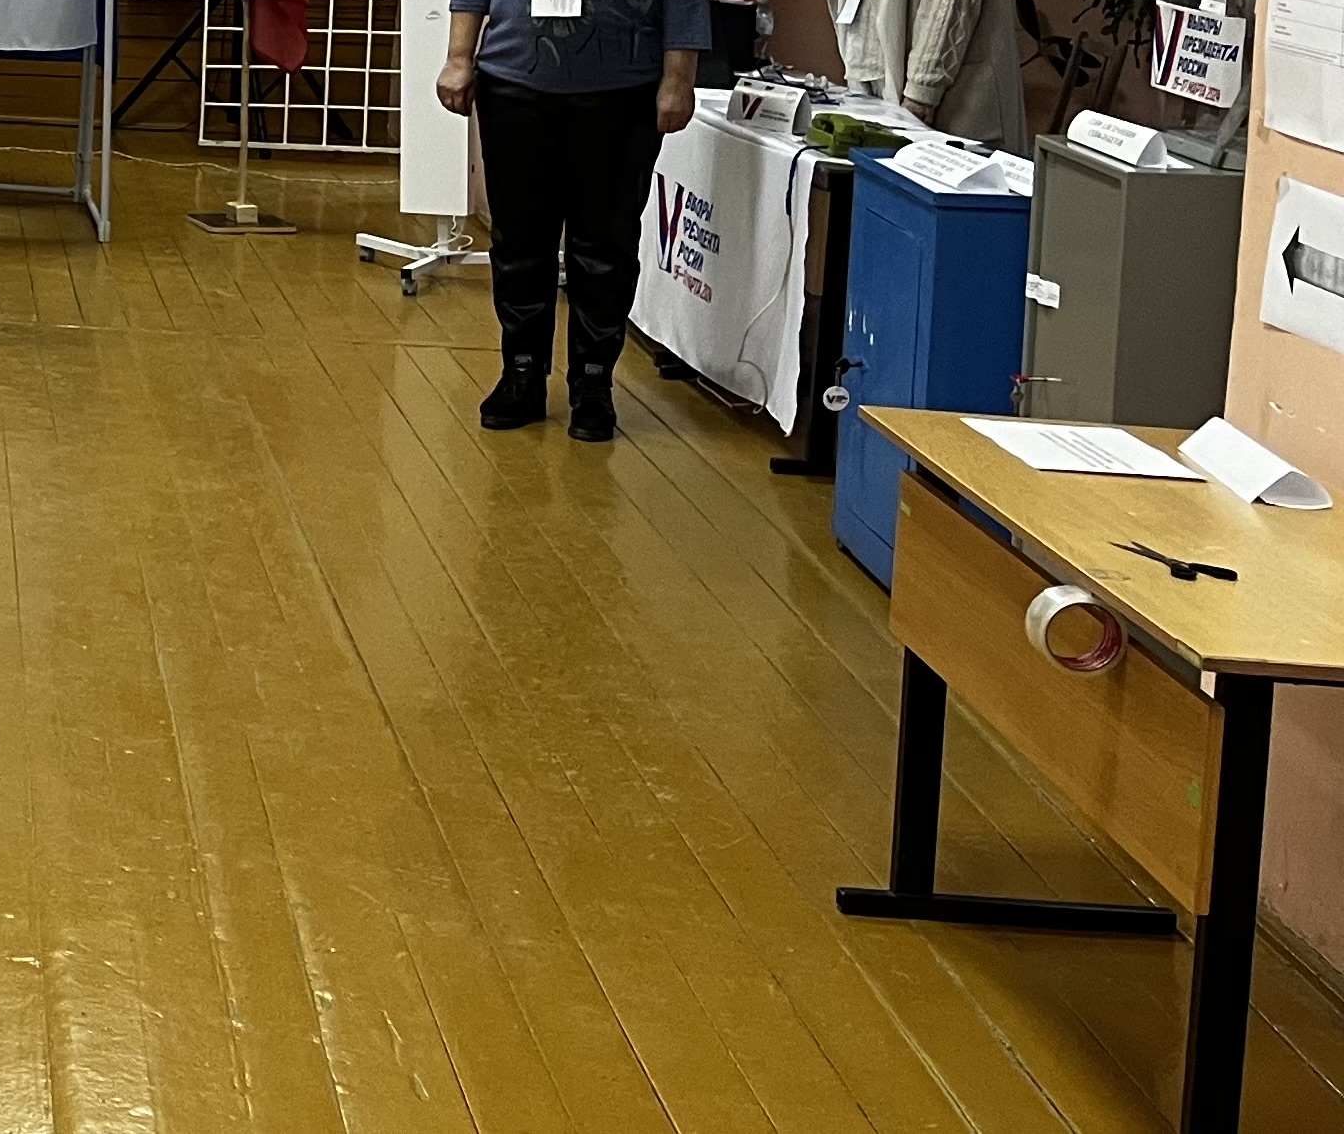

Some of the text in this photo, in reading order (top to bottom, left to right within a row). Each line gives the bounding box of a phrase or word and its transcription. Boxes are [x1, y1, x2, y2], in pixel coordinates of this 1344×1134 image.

[1187, 14, 1222, 35] ВЫБОРЫ
[1182, 35, 1239, 62] ПРЕЗИДЕНТА
[1177, 56, 1209, 78] РОССИИ
